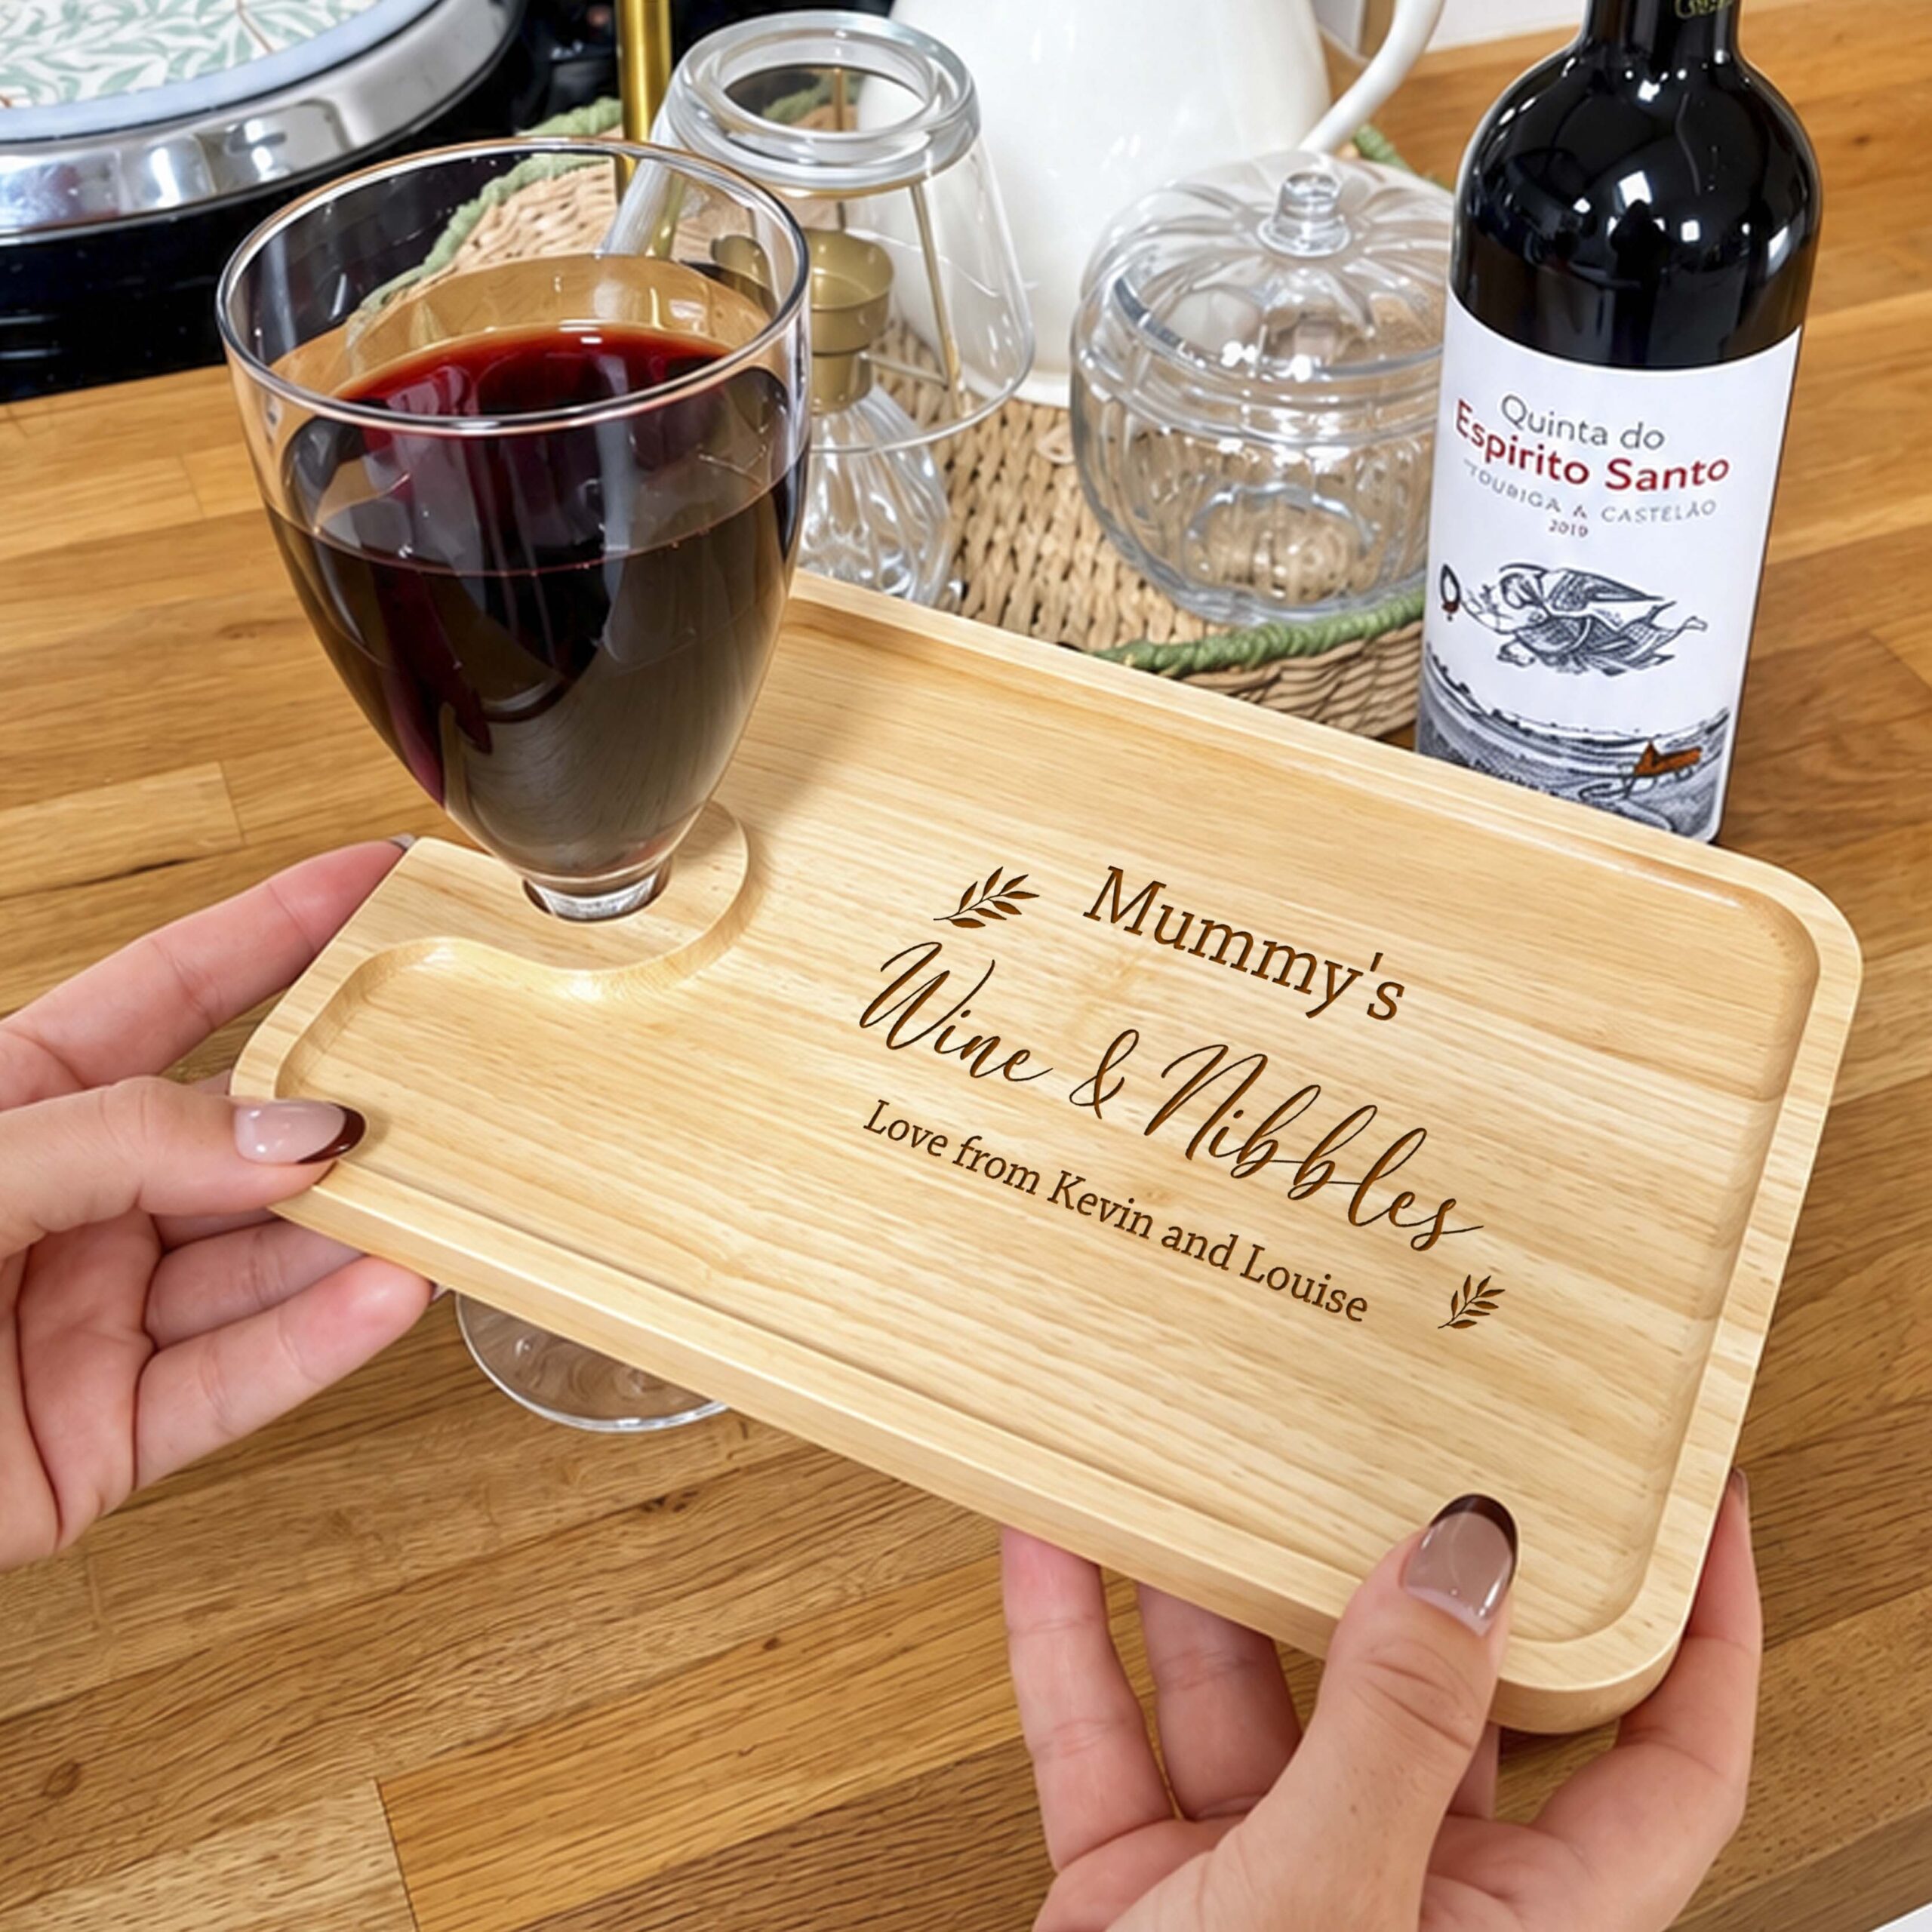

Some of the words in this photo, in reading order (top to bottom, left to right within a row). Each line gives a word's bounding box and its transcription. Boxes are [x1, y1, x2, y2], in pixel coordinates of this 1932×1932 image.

[1456, 399, 1589, 485] Espirito
[1605, 458, 1730, 492] Santo
[1502, 395, 1607, 446] Quinta
[1620, 423, 1665, 450] do
[1083, 866, 1405, 1021] Mummy's
[859, 942, 1054, 1081] Wine
[1069, 1029, 1140, 1119] &
[1144, 1044, 1484, 1251] Nibbles
[863, 1100, 949, 1157] Love
[952, 1136, 1041, 1195] from
[1047, 1171, 1155, 1240] Kevin
[1161, 1225, 1239, 1272] and
[1238, 1245, 1369, 1323] Louise
